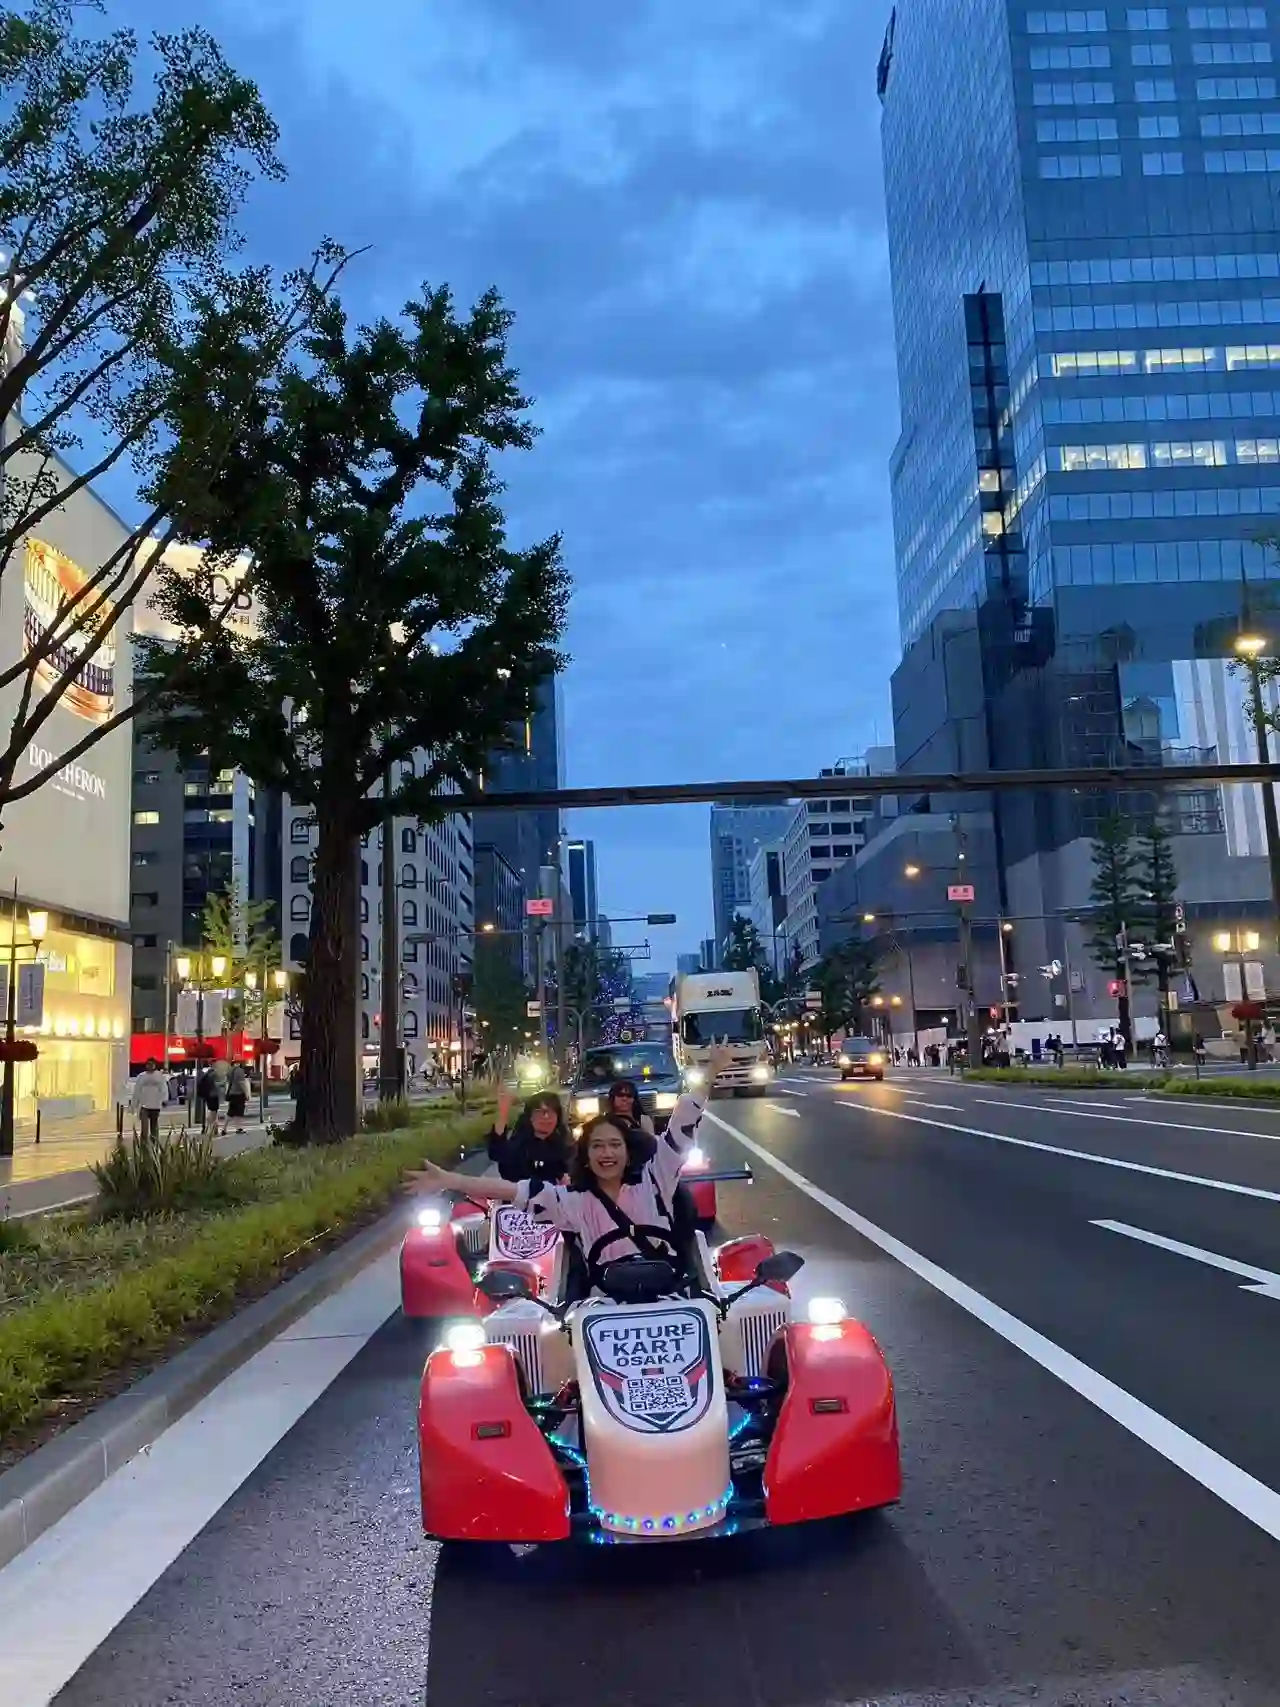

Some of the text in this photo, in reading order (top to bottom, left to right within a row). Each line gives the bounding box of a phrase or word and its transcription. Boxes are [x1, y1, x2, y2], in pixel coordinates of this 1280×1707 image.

[599, 1323, 695, 1341] FUTURE
[613, 1337, 685, 1356] KART
[616, 1353, 685, 1366] OSAKA
